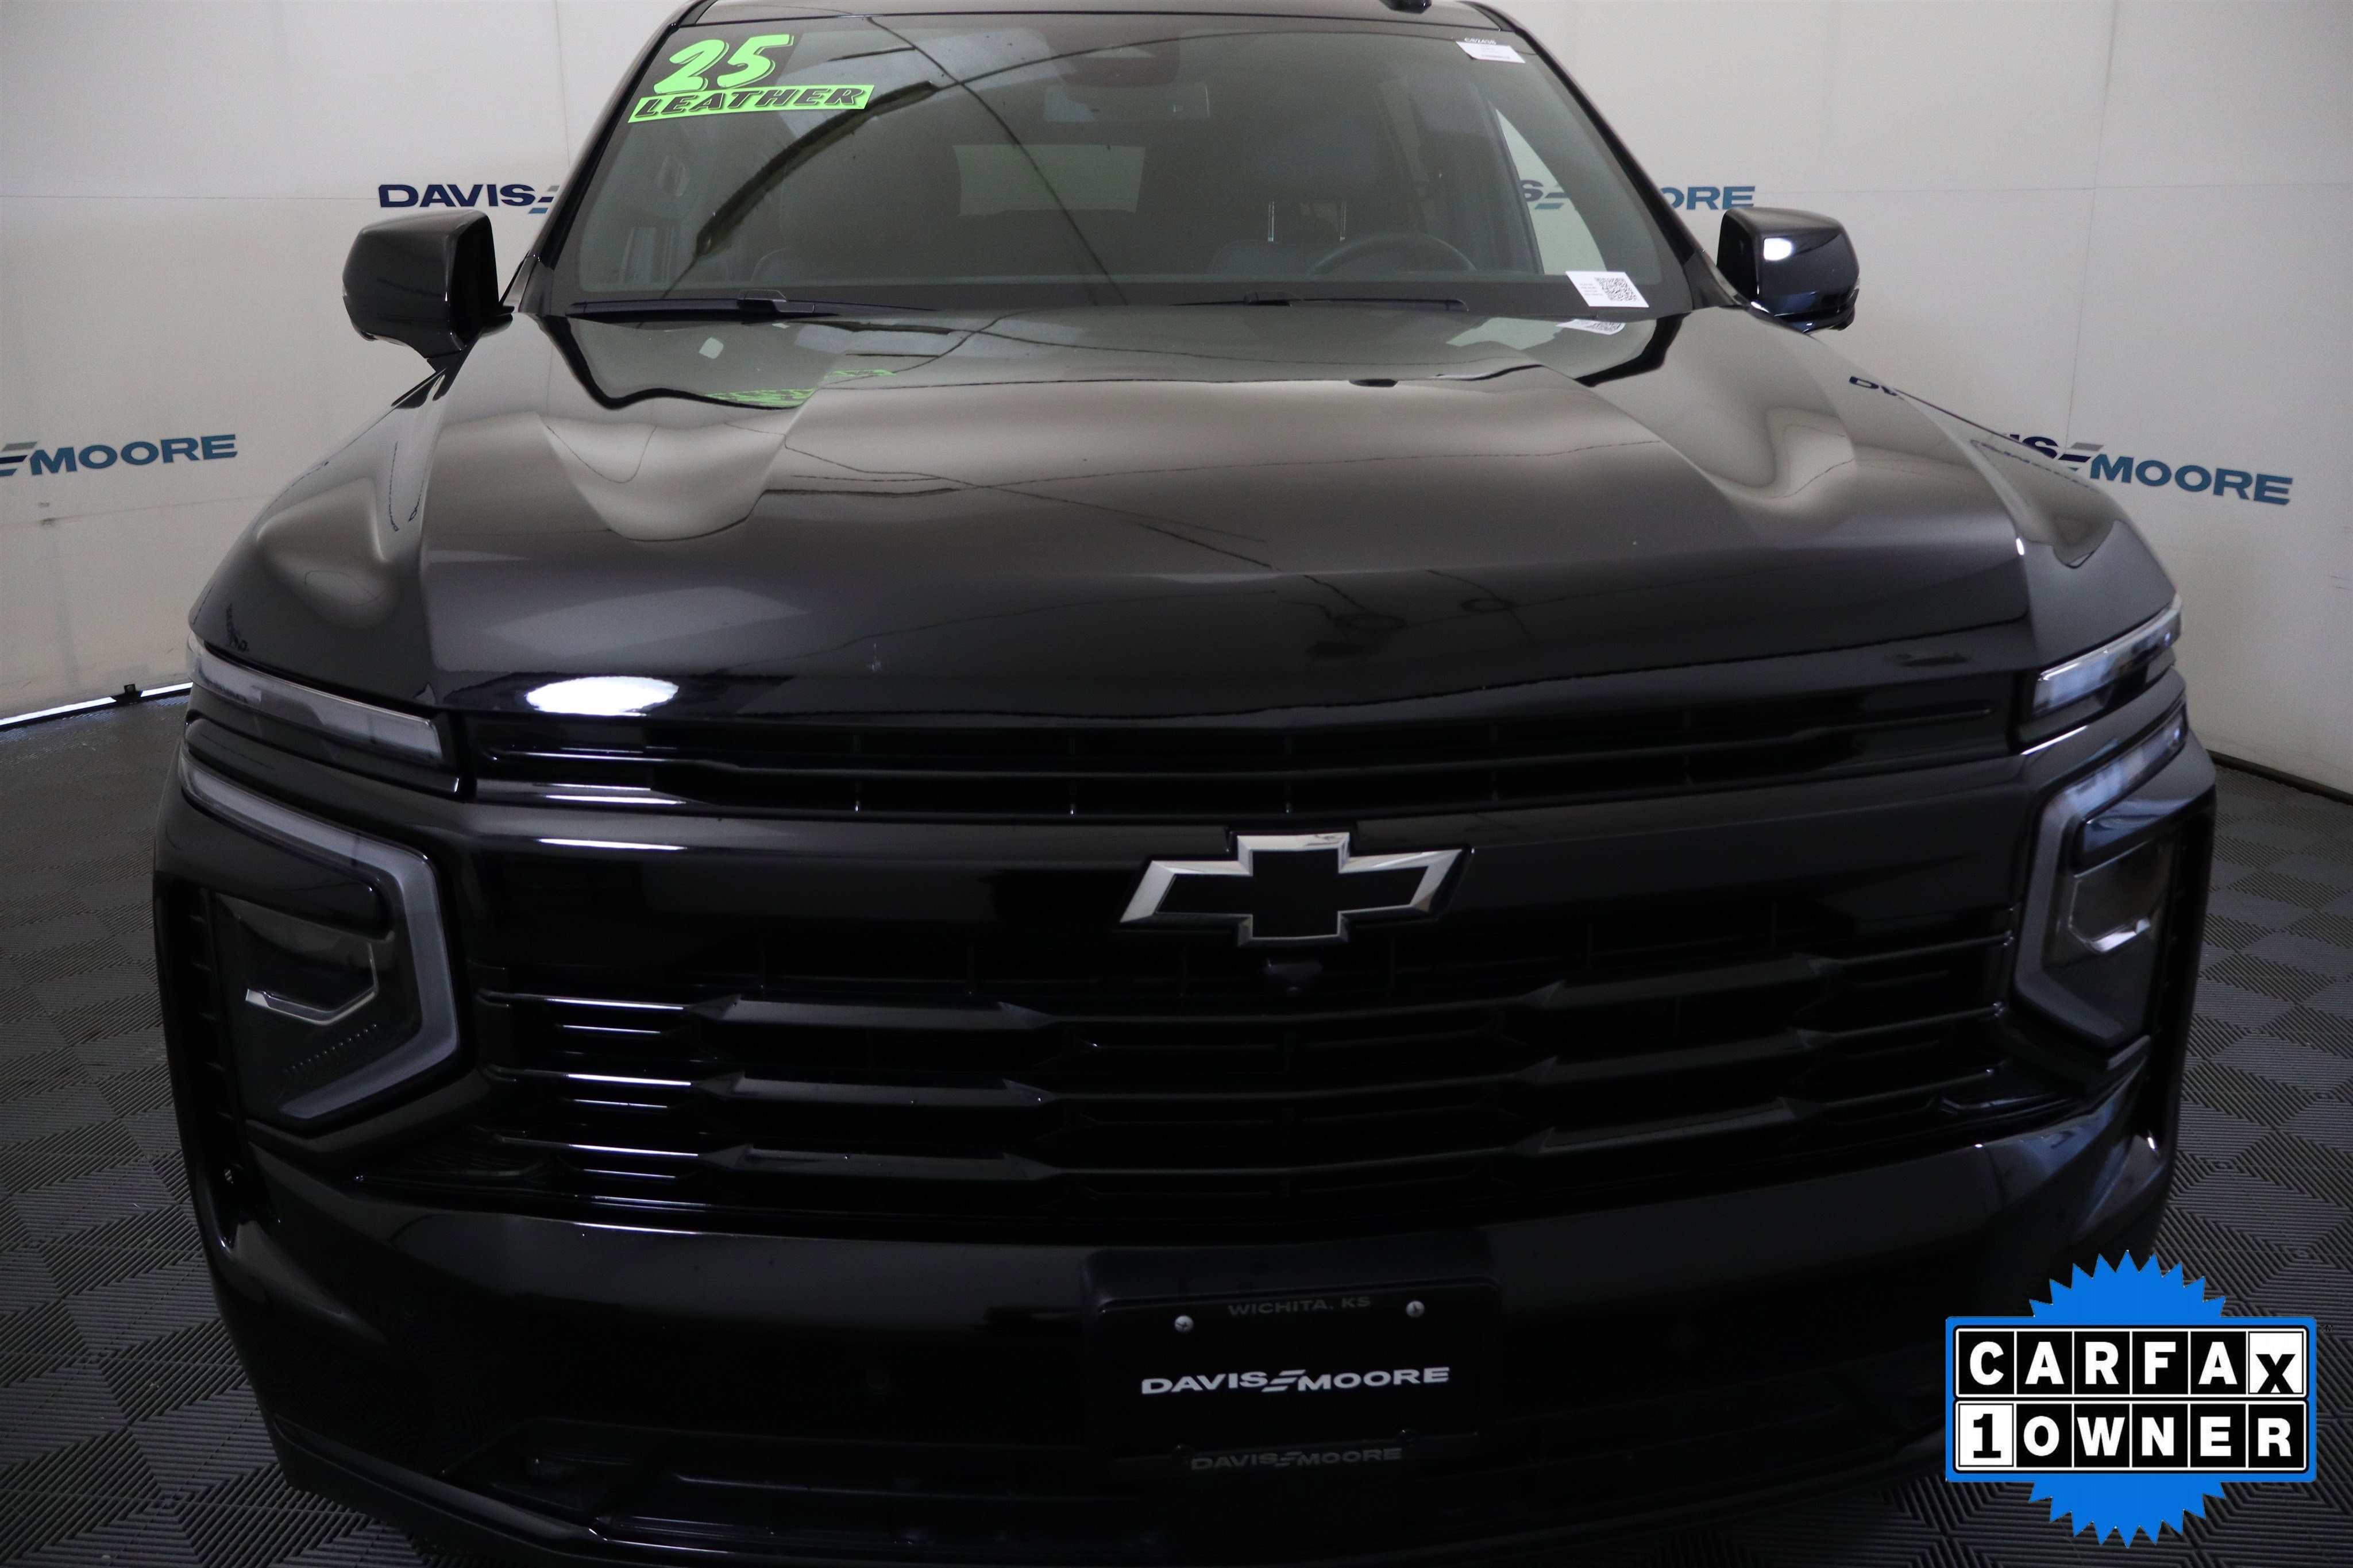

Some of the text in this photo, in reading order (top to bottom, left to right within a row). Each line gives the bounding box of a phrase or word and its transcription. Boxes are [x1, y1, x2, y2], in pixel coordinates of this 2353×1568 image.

[654, 34, 794, 94] 25
[634, 88, 864, 117] LEATHER
[379, 184, 535, 207] DAVIS
[1661, 186, 1755, 210] ORE
[30, 434, 237, 476] MOORE
[2090, 454, 2293, 505] MOORE
[1341, 1296, 1371, 1308] KS
[1141, 1366, 1450, 1395] DAVIS MOORE
[1190, 1448, 1403, 1470] DAVIS MOORE
